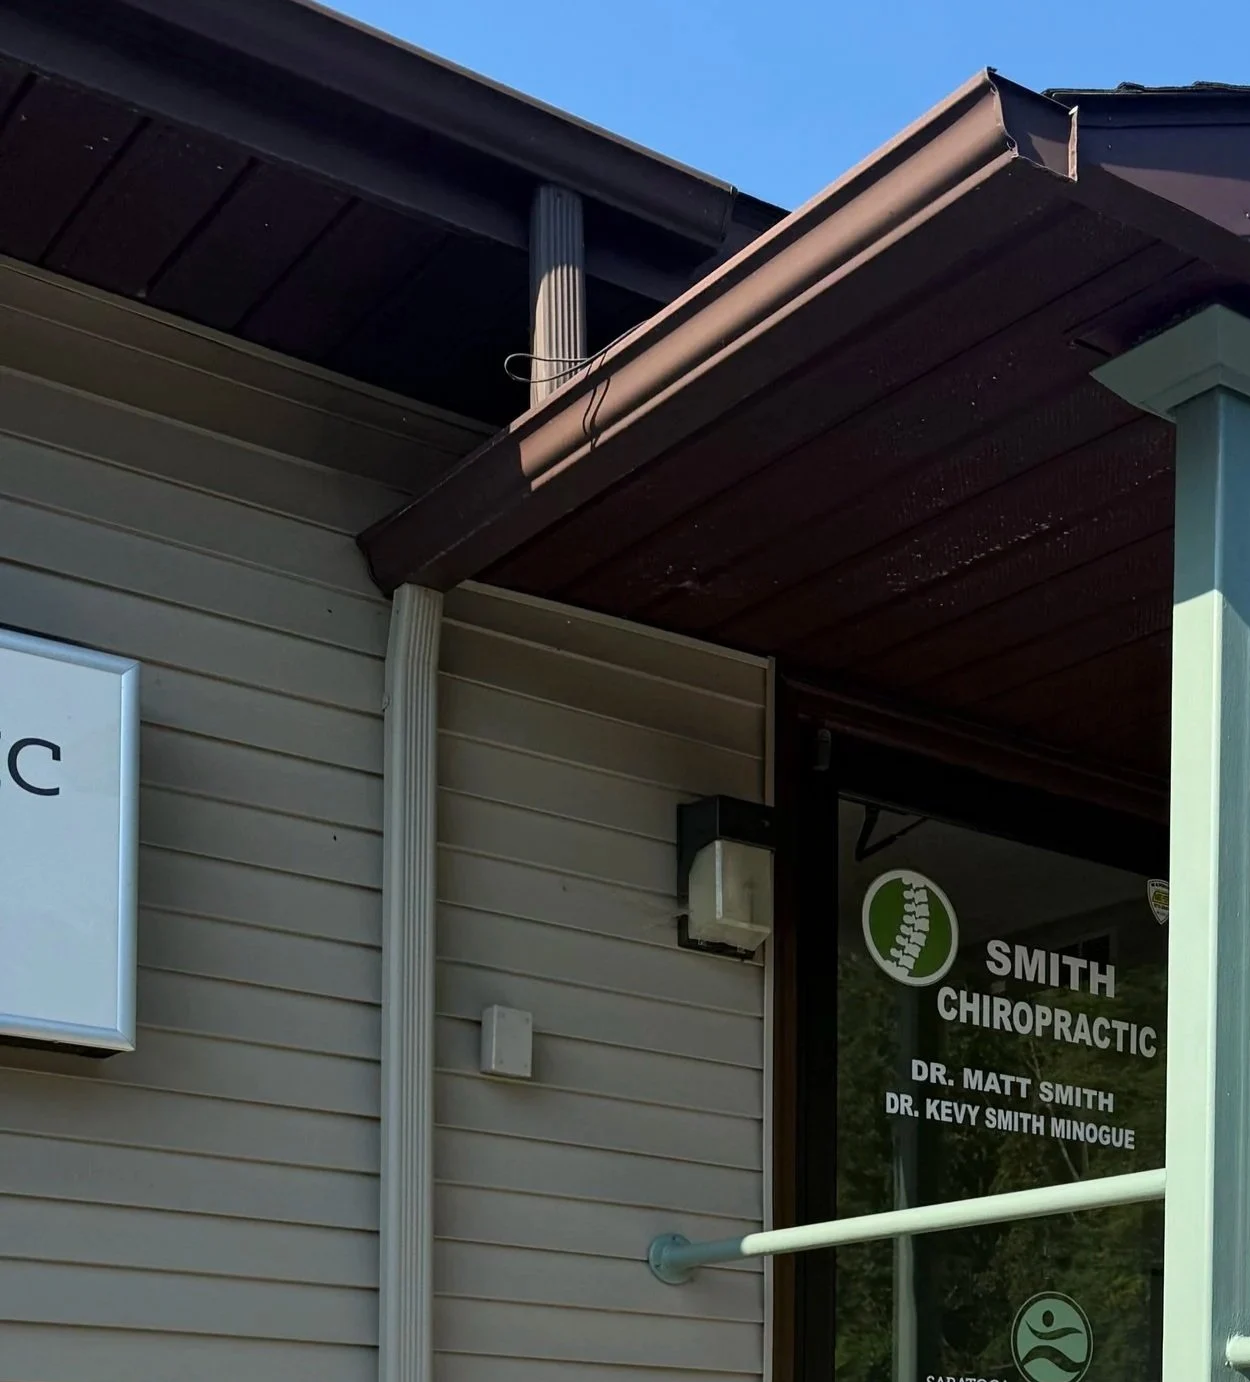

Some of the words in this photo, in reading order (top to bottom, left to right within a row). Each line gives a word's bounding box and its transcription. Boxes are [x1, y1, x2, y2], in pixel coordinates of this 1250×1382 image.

[985, 939, 1116, 998] SMITH
[937, 986, 1157, 1058] CHIROPRACTIC
[911, 1058, 954, 1087] DR.
[962, 1067, 1032, 1099] MATT
[1038, 1081, 1114, 1113] SMITH
[885, 1091, 919, 1118] DR.
[925, 1098, 980, 1126] KEVY
[985, 1107, 1045, 1136] SMITH
[1050, 1116, 1135, 1150] MINOGUE
